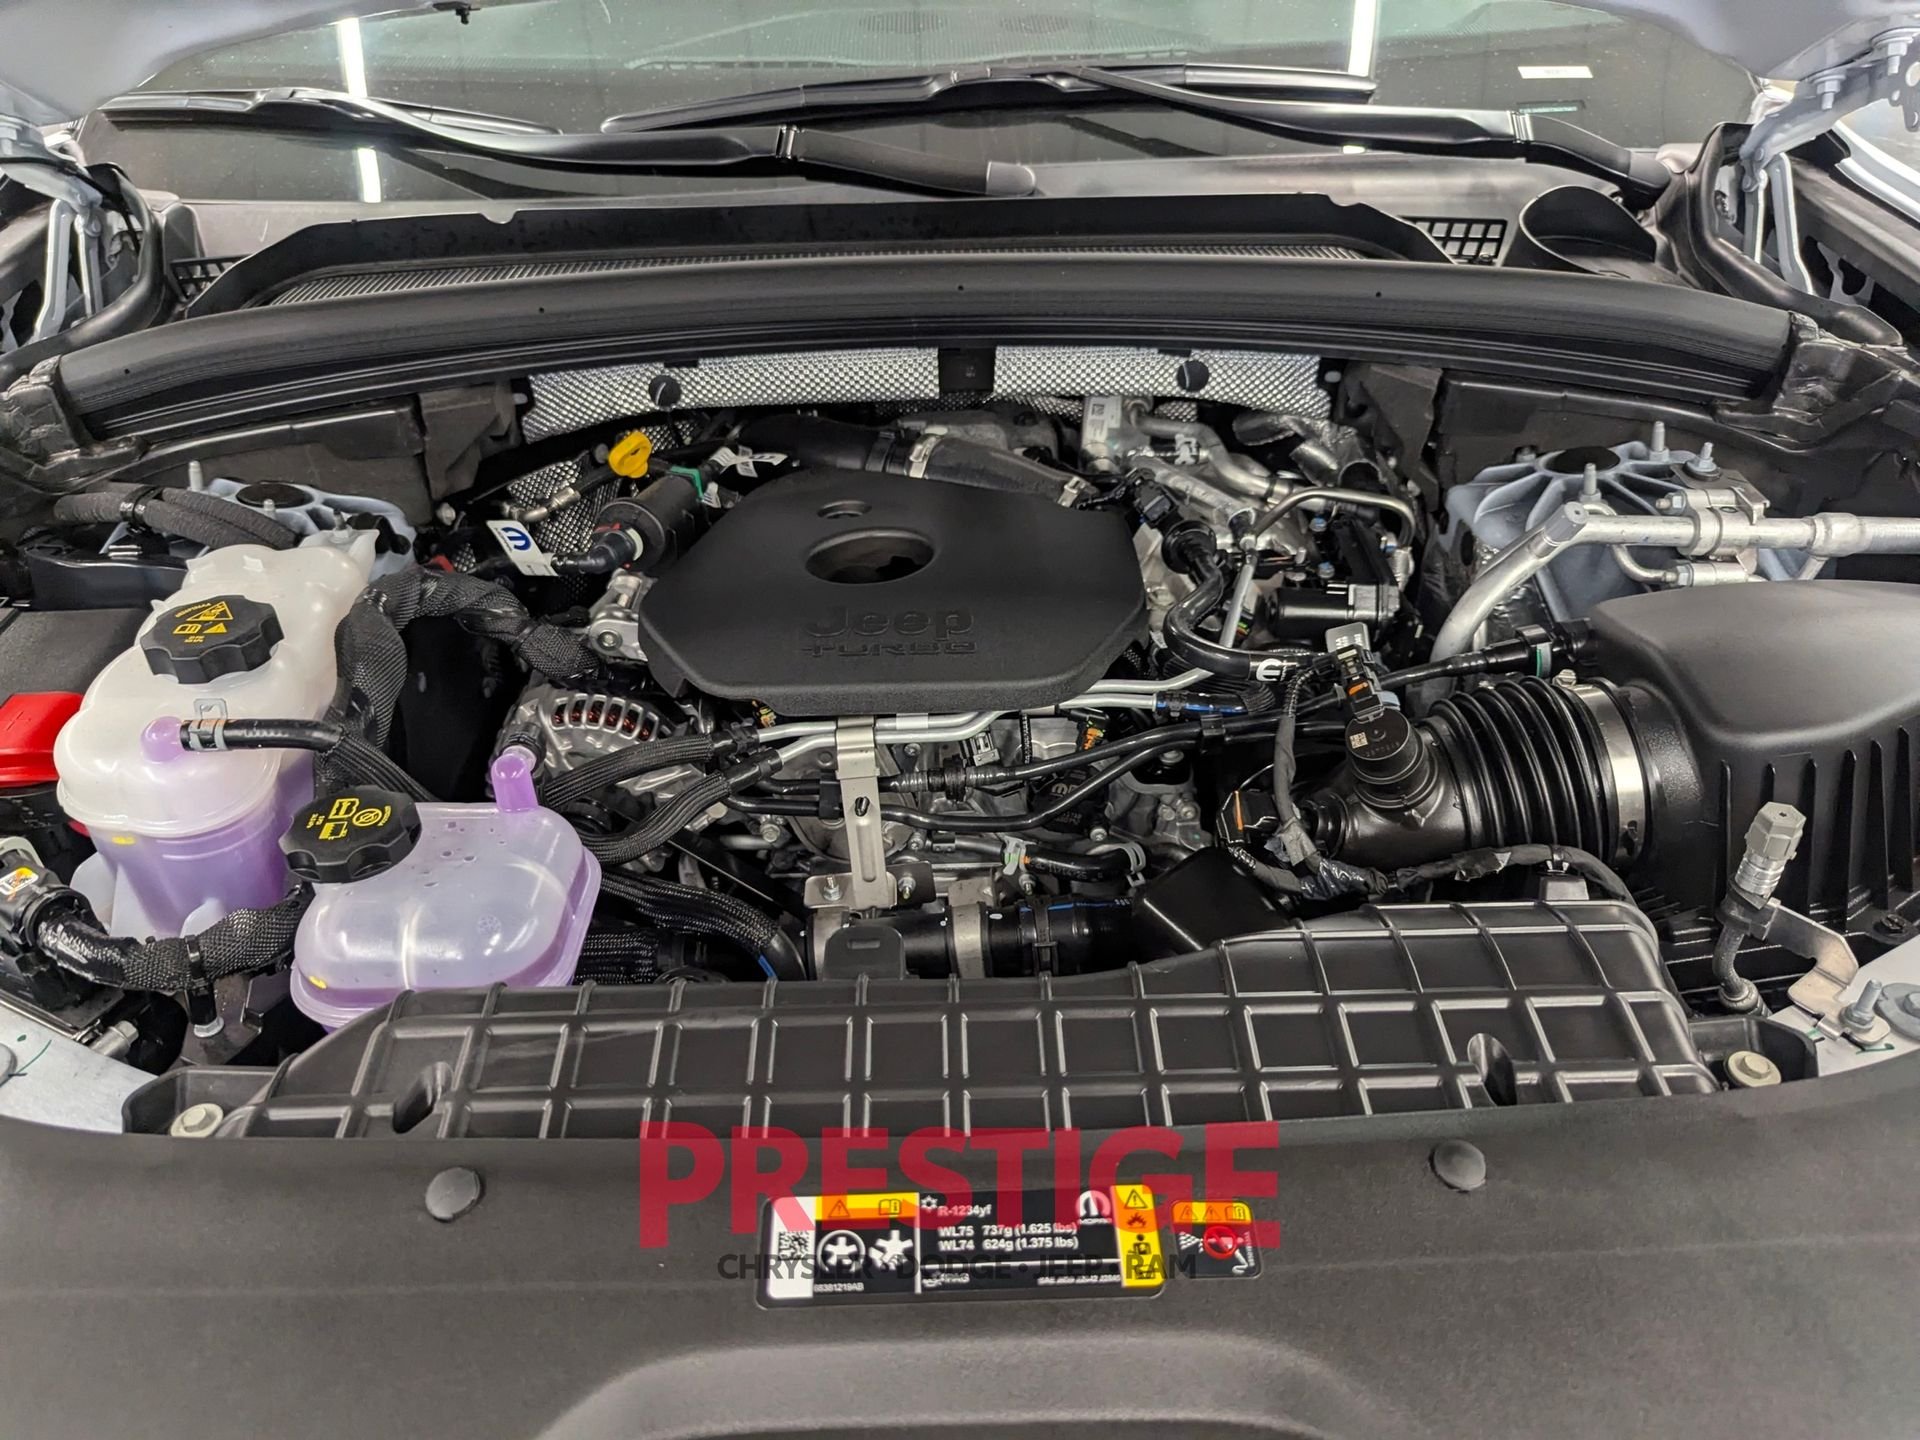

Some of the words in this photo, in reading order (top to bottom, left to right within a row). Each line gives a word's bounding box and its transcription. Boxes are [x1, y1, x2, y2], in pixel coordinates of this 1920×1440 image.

[804, 604, 974, 642] Jeep
[802, 640, 977, 658] TURBO
[937, 1203, 992, 1218] R-1234yf
[938, 1225, 975, 1238] WL75
[982, 1224, 1013, 1238] 737g
[1015, 1223, 1051, 1237] (1.625
[1053, 1221, 1079, 1235] lbs)
[938, 1239, 975, 1252] WL74
[982, 1239, 1014, 1252] 624g
[1016, 1238, 1052, 1250] (1.375
[1054, 1237, 1079, 1249] lbs)
